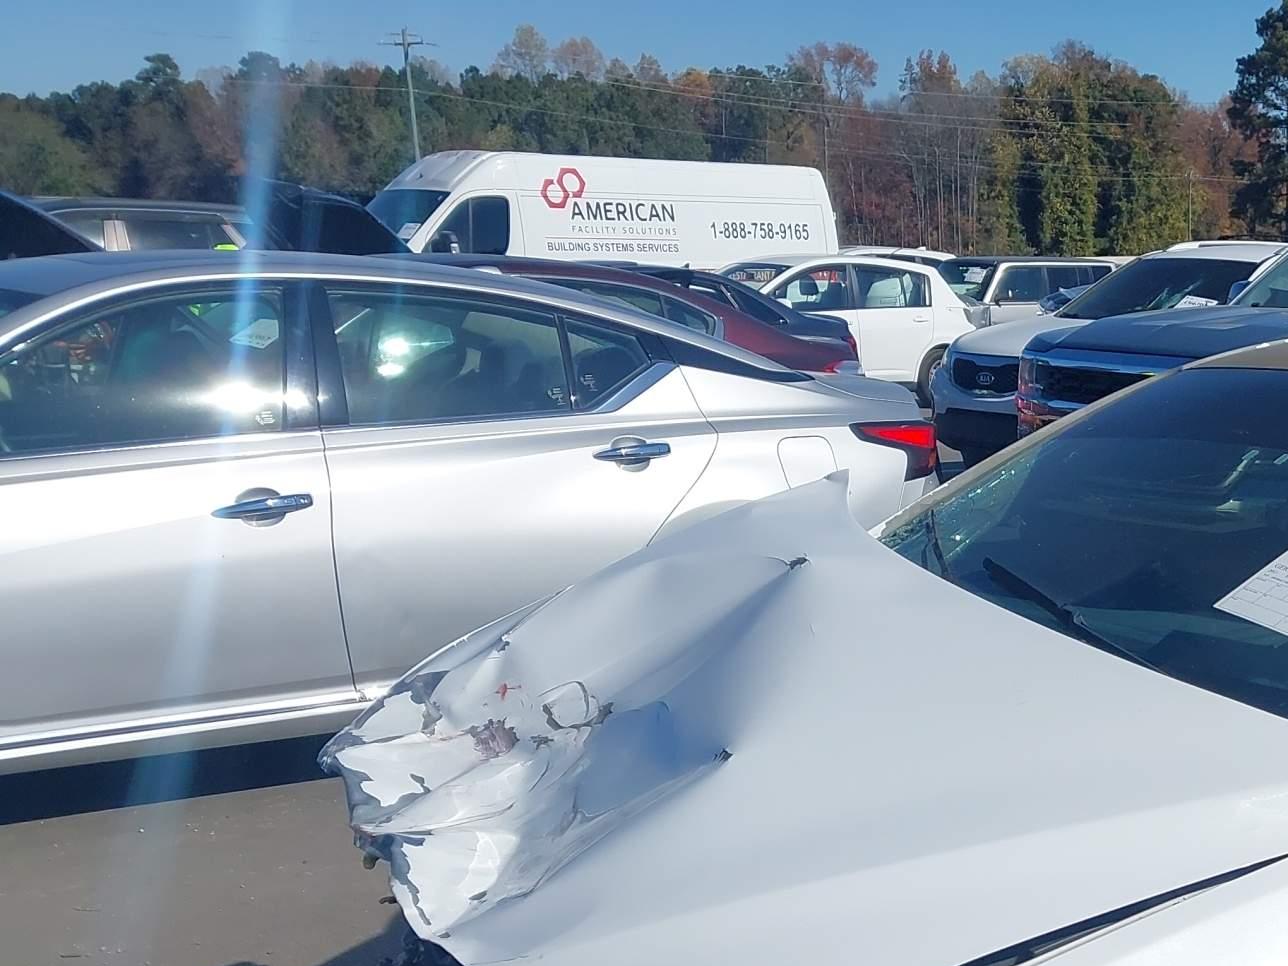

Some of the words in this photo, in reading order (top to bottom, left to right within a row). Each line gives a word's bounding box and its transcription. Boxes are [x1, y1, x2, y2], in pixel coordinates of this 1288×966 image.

[571, 201, 676, 222] AMERICAN
[572, 225, 616, 234] FACILITY
[622, 226, 677, 236] SOLUTIONS
[710, 221, 810, 240] 1-888-758-9165
[547, 242, 591, 252] BUILDING
[593, 242, 634, 252] SYSTEMS
[637, 243, 679, 253] SERVICES
